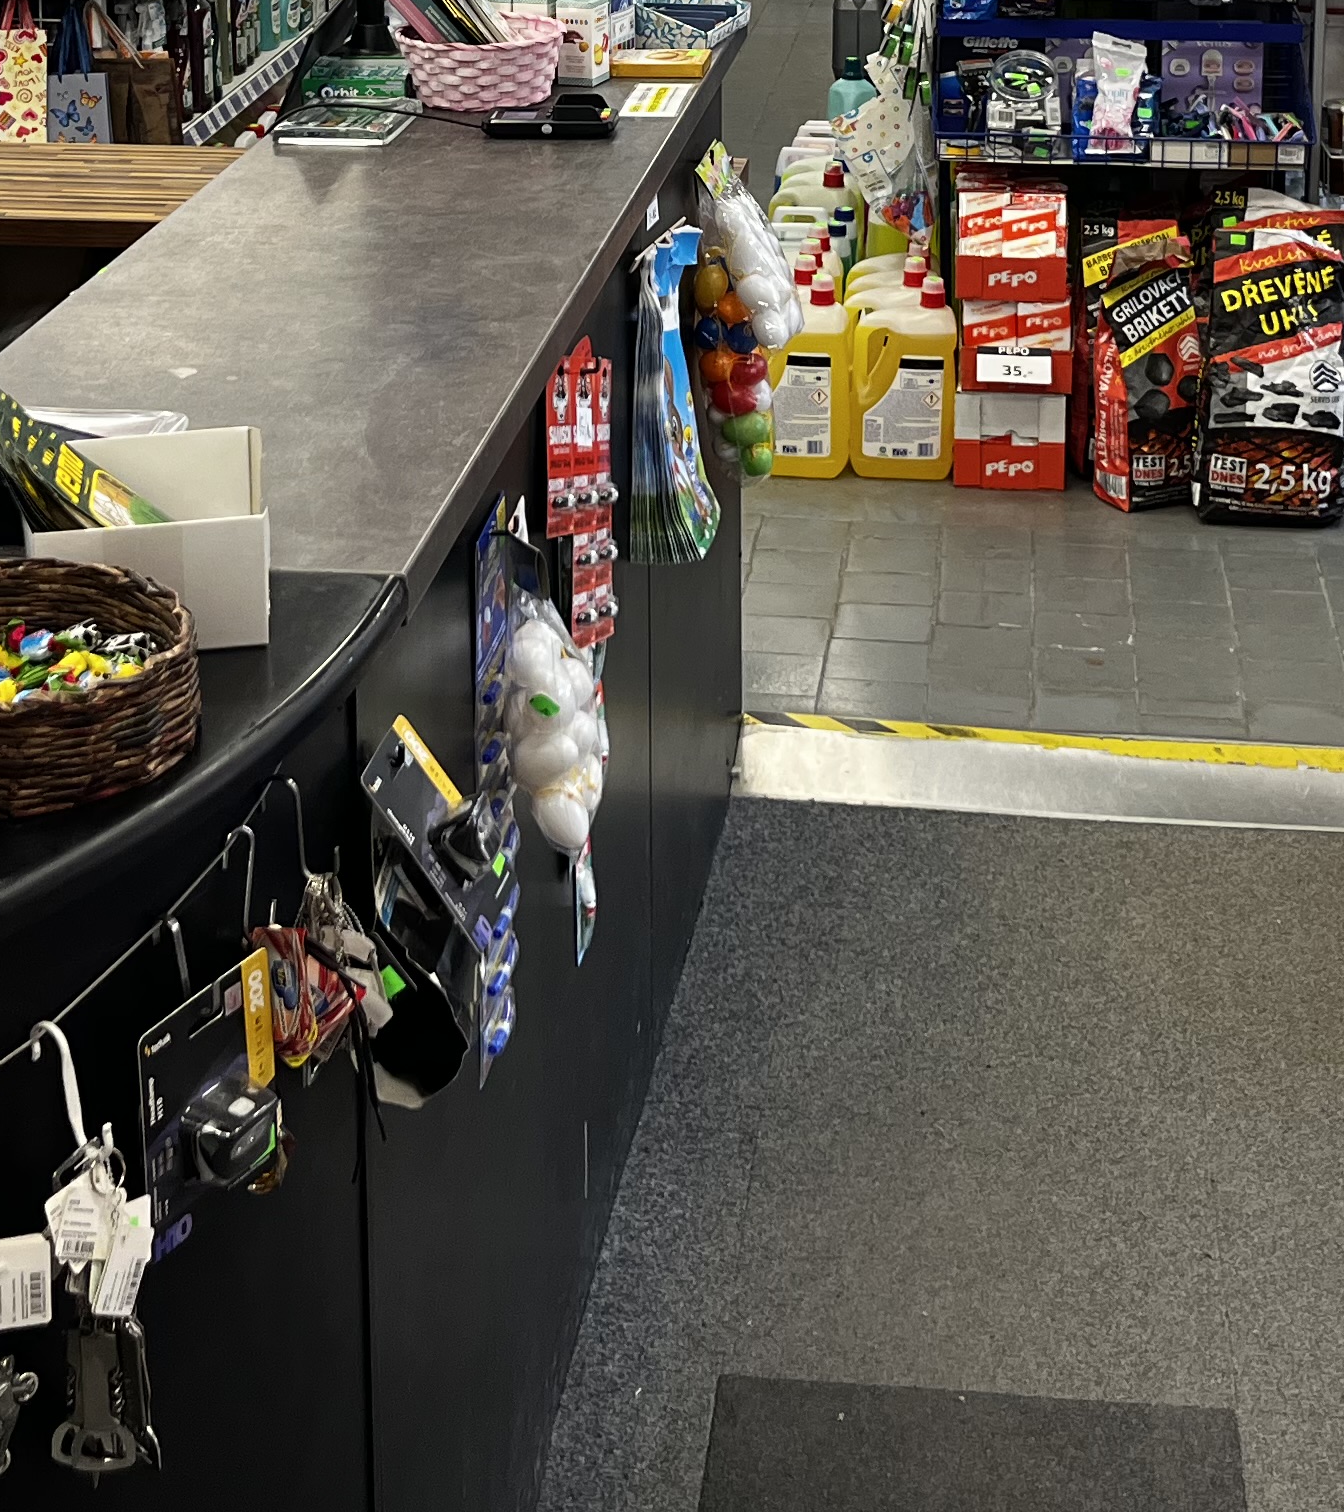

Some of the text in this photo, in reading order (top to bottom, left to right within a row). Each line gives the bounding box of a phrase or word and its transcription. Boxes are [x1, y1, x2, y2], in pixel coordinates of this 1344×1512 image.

[963, 35, 1019, 49] Gillette
[321, 86, 359, 98] Orbit
[1012, 218, 1049, 232] PEPO
[1084, 224, 1114, 238] 2,5 kg
[987, 270, 1037, 287] PEPO
[1221, 266, 1336, 313] DŘEVĚNÉ
[1112, 273, 1183, 324] GRILOVACÍ
[1026, 316, 1062, 328] PEPO
[1121, 288, 1192, 343] BRIKETY
[972, 325, 1009, 338] PEPO
[998, 346, 1030, 356] PEPO
[985, 459, 1034, 476] PEPO
[1133, 455, 1164, 470] TEST
[1213, 455, 1247, 471] TEST
[1134, 468, 1164, 480] DNES
[1211, 470, 1246, 485] DNES
[1255, 463, 1332, 498] 2,5 kg
